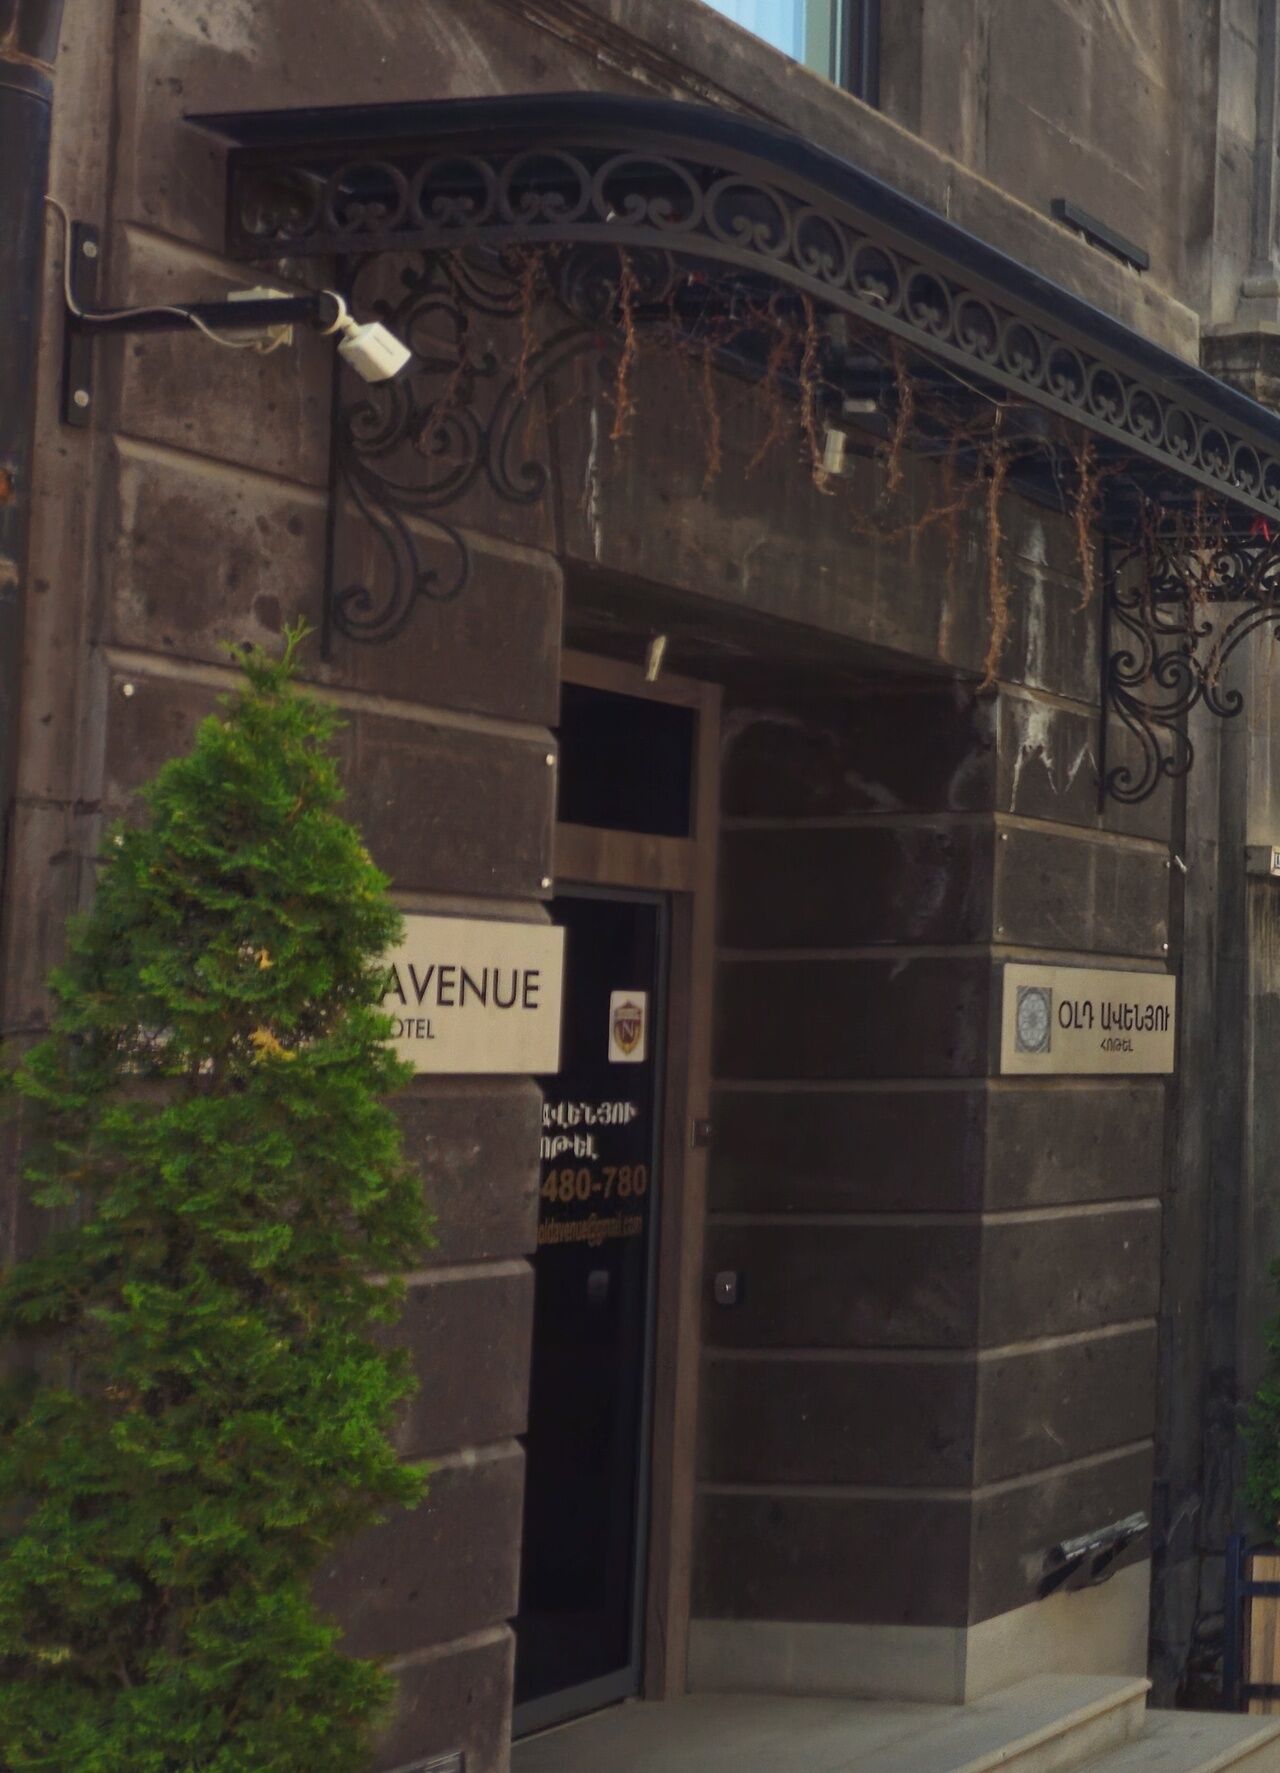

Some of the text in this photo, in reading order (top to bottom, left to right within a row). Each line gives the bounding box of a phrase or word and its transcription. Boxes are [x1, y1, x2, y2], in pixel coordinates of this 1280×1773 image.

[380, 962, 540, 1009] AVENUE
[393, 1018, 435, 1039] OTEL
[1058, 1000, 1170, 1031] ՕԼԴ ԱՎԵՆՅՈՒ
[1100, 1038, 1134, 1052] ՀՈԹԵԼ
[540, 1133, 599, 1161] ՈԹԵԼ
